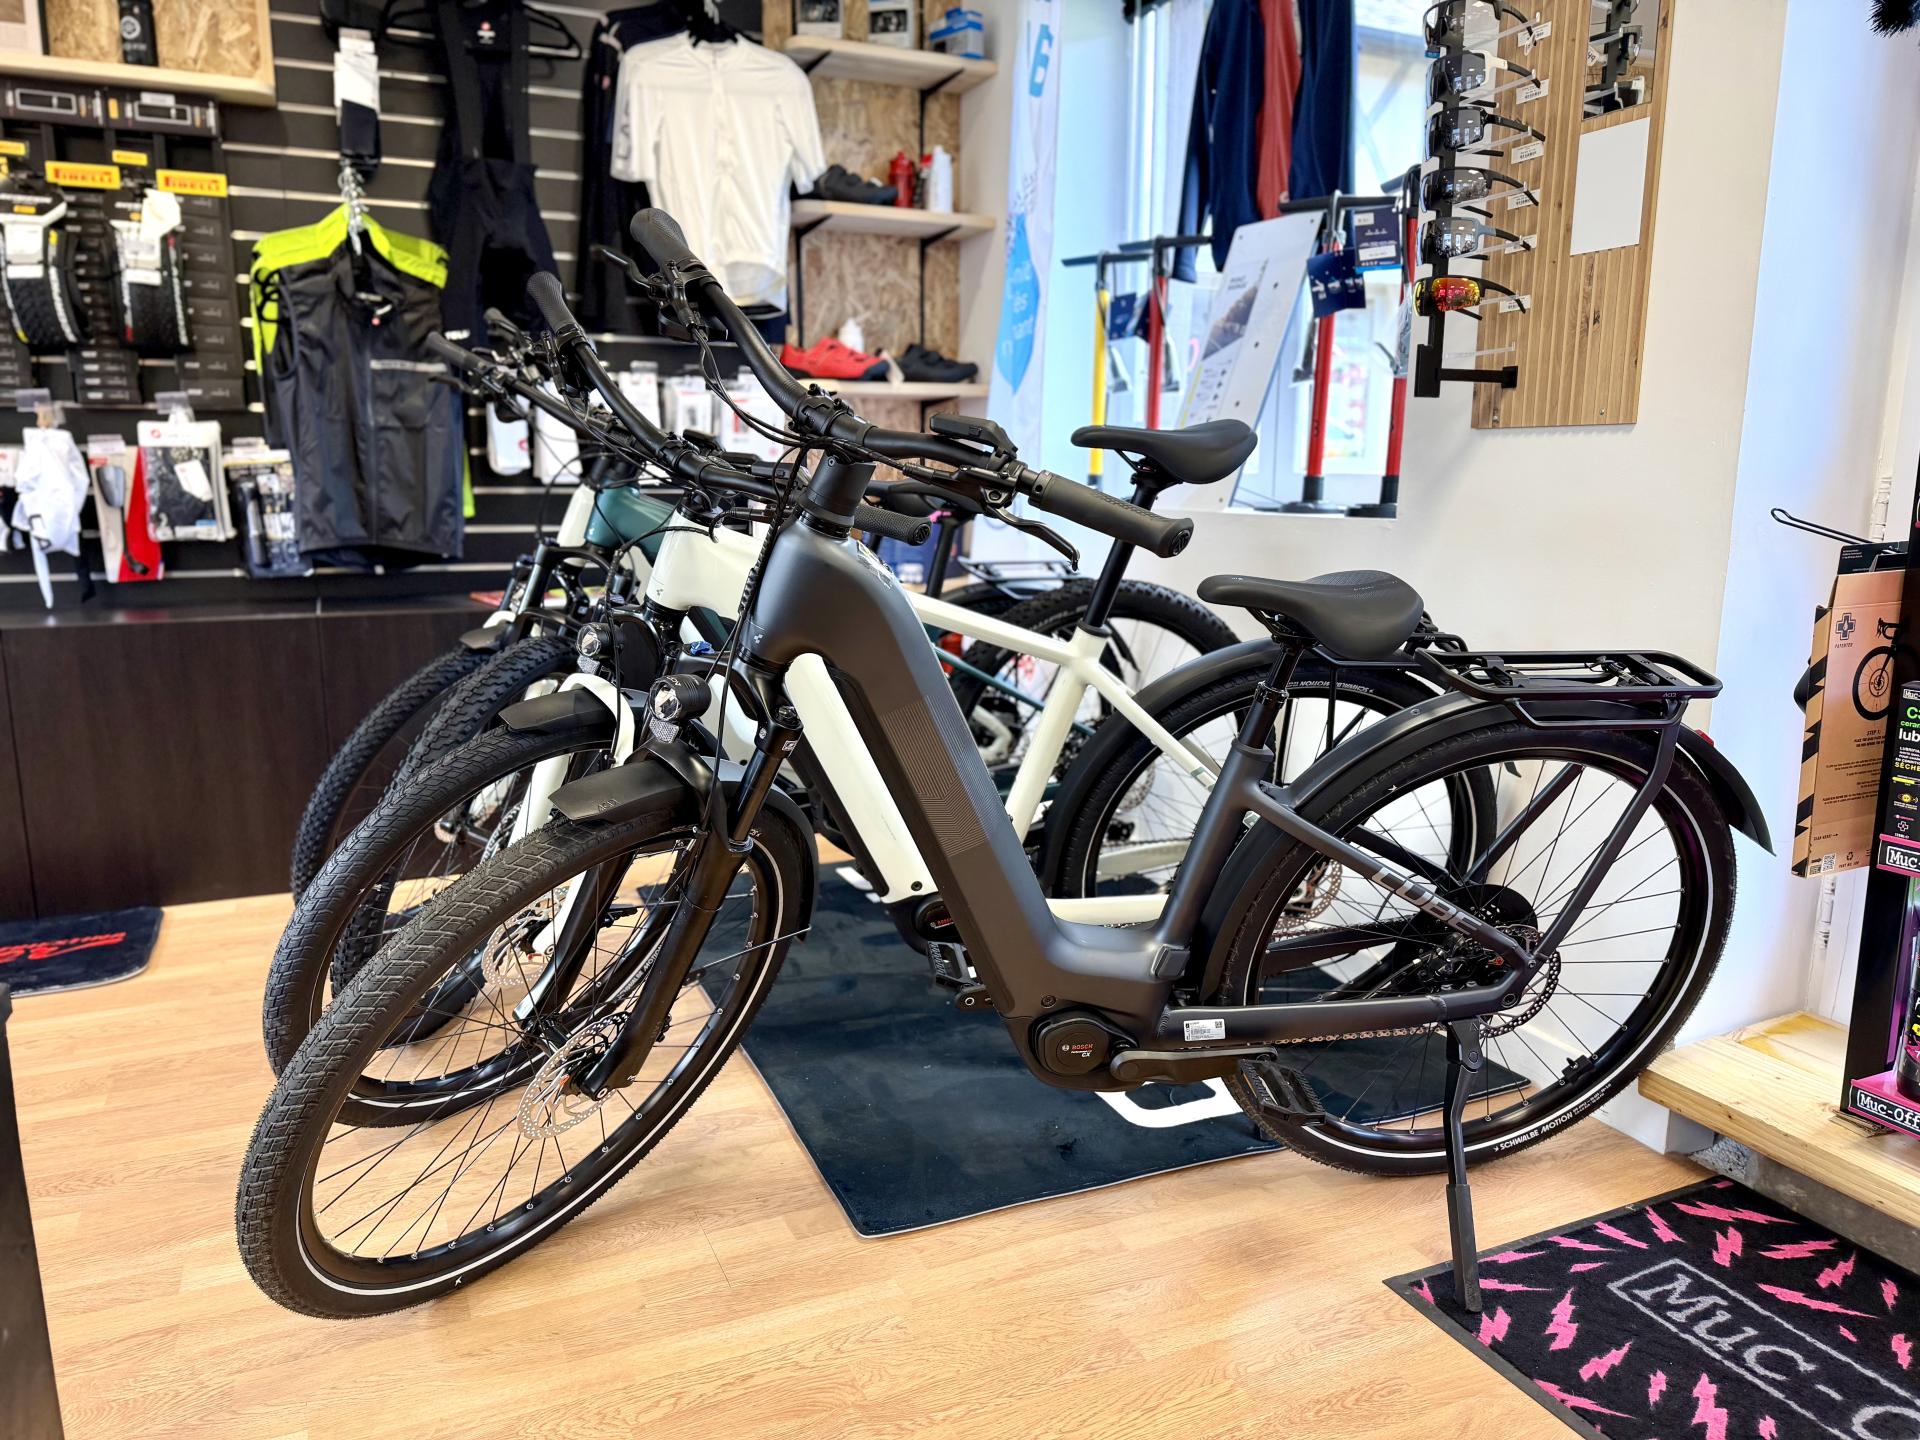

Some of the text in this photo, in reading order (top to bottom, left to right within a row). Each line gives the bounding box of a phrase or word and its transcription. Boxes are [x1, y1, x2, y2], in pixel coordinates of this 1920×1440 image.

[53, 167, 113, 184] PIRELLI
[163, 175, 220, 192] PIRELLI
[1371, 866, 1483, 936] CUBE
[1071, 1043, 1094, 1051] BOSCH
[1860, 1093, 1920, 1130] Muc-Off
[1500, 1111, 1574, 1151] SCHWALBE MOTION
